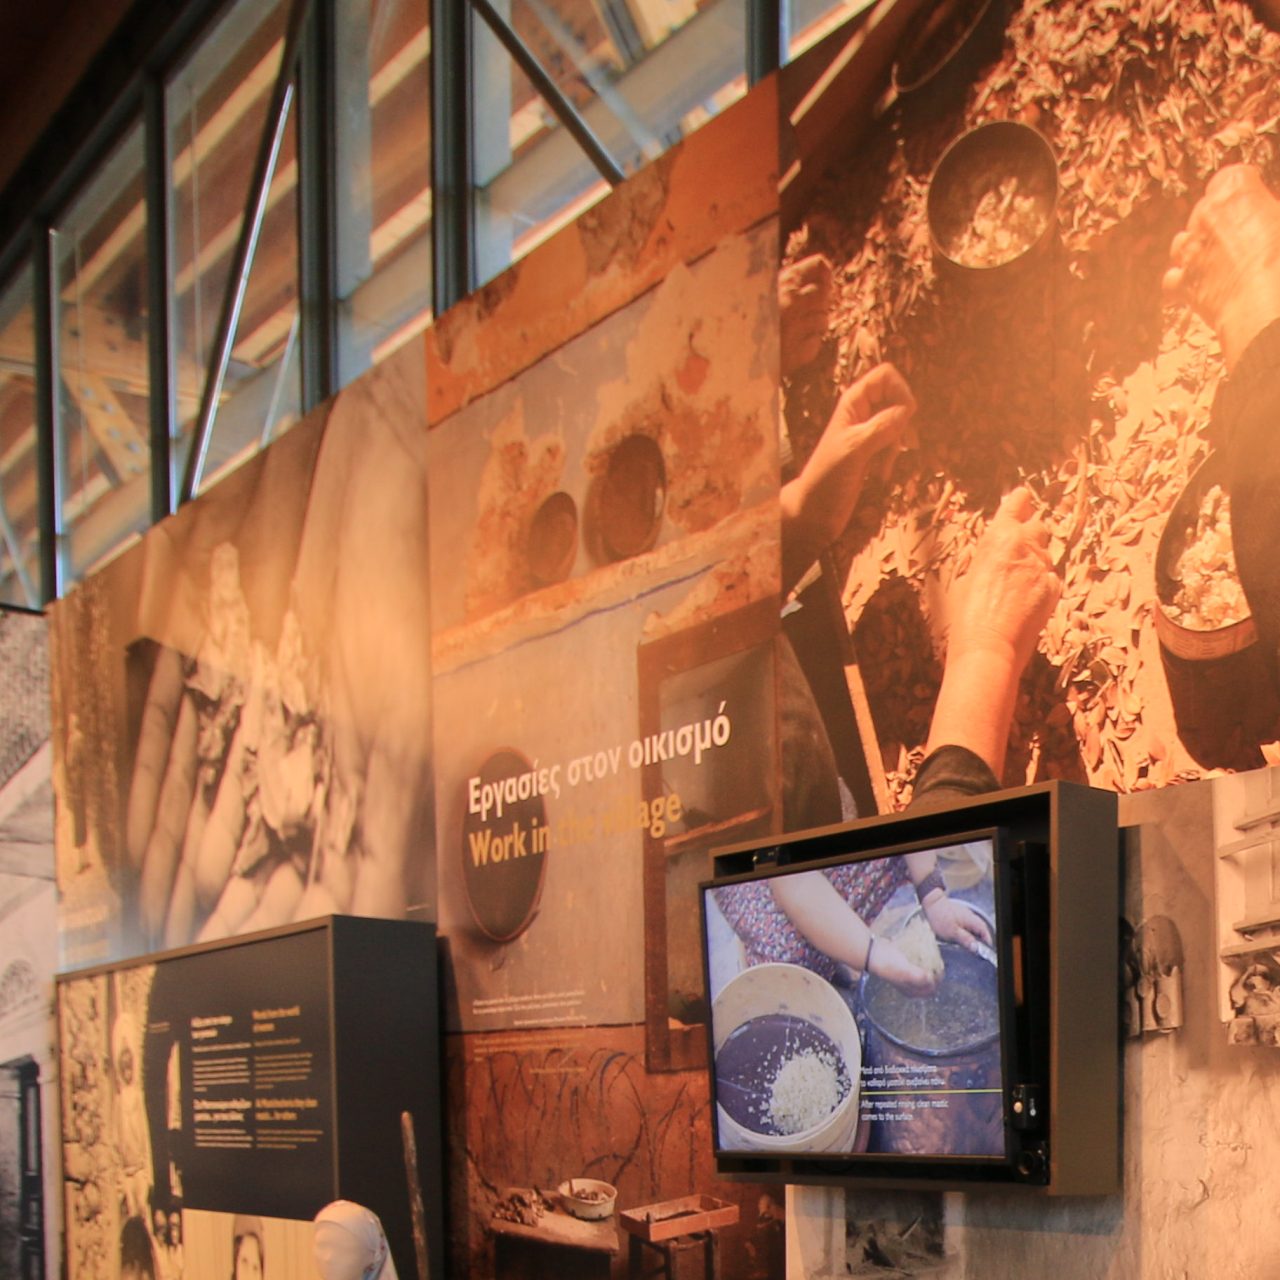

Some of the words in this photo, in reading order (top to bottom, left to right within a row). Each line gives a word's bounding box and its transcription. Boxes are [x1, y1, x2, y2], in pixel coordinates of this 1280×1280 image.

[468, 759, 560, 822] Εργασίες
[568, 746, 621, 787] στον
[629, 701, 730, 767] οικισμό
[469, 827, 525, 867] Work
[533, 820, 550, 854] in
[559, 813, 595, 846] the
[602, 791, 681, 838] village
